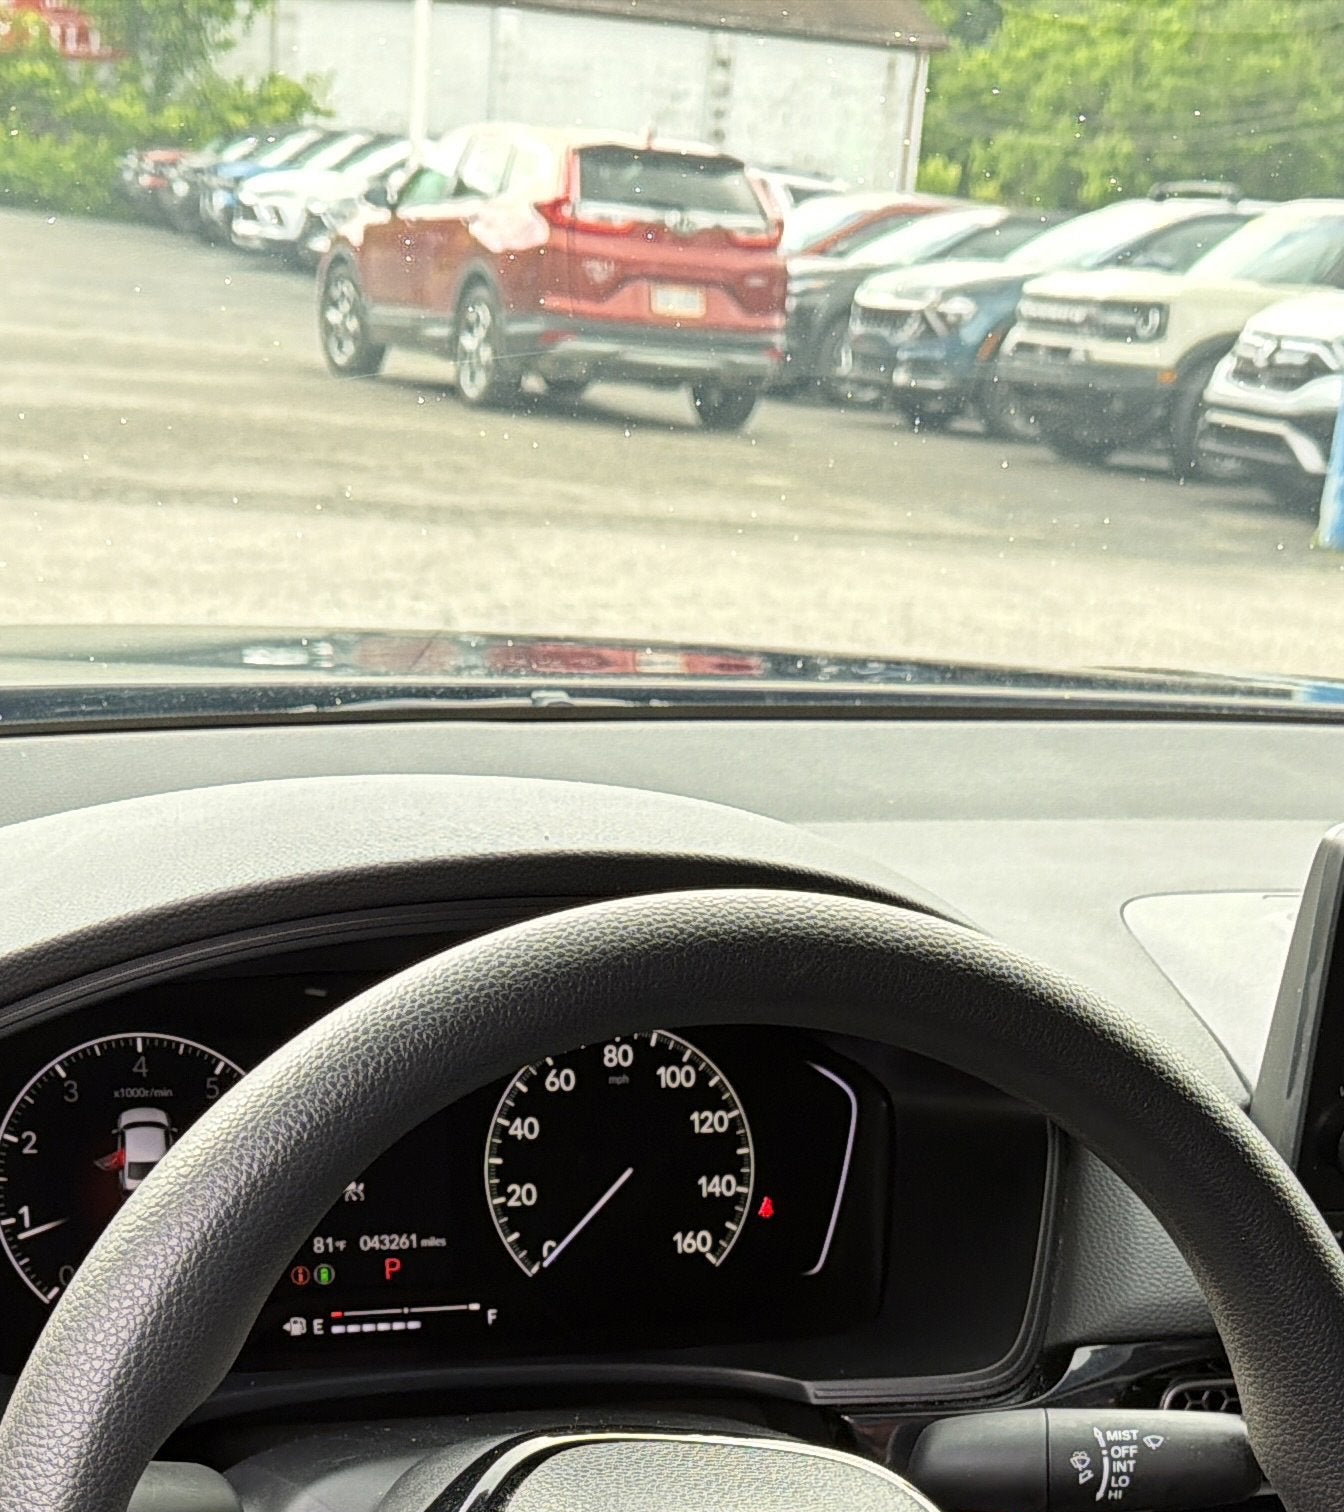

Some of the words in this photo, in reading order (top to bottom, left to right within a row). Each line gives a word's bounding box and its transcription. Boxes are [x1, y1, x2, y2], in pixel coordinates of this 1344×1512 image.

[133, 1056, 149, 1077] 4
[603, 1044, 634, 1067] 80
[206, 1079, 220, 1098] 5
[544, 1067, 576, 1092] 60
[608, 1074, 630, 1086] mph
[656, 1066, 696, 1089] 100
[63, 1080, 79, 1102] 3
[508, 1116, 540, 1140] 40
[690, 1110, 730, 1134] 120
[21, 1131, 38, 1154] 2
[506, 1182, 538, 1207] 20
[698, 1174, 737, 1198] 140
[17, 1205, 31, 1229] 1
[359, 1233, 418, 1252] 043261
[420, 1236, 447, 1248] miles
[673, 1229, 713, 1255] 160
[384, 1257, 401, 1280] P
[312, 1318, 325, 1335] E
[486, 1308, 498, 1326] F
[1106, 1429, 1139, 1442] MIST
[1110, 1445, 1139, 1459] OFF
[1112, 1460, 1137, 1473] INT
[1110, 1475, 1130, 1488] LO
[1107, 1489, 1123, 1501] HI
